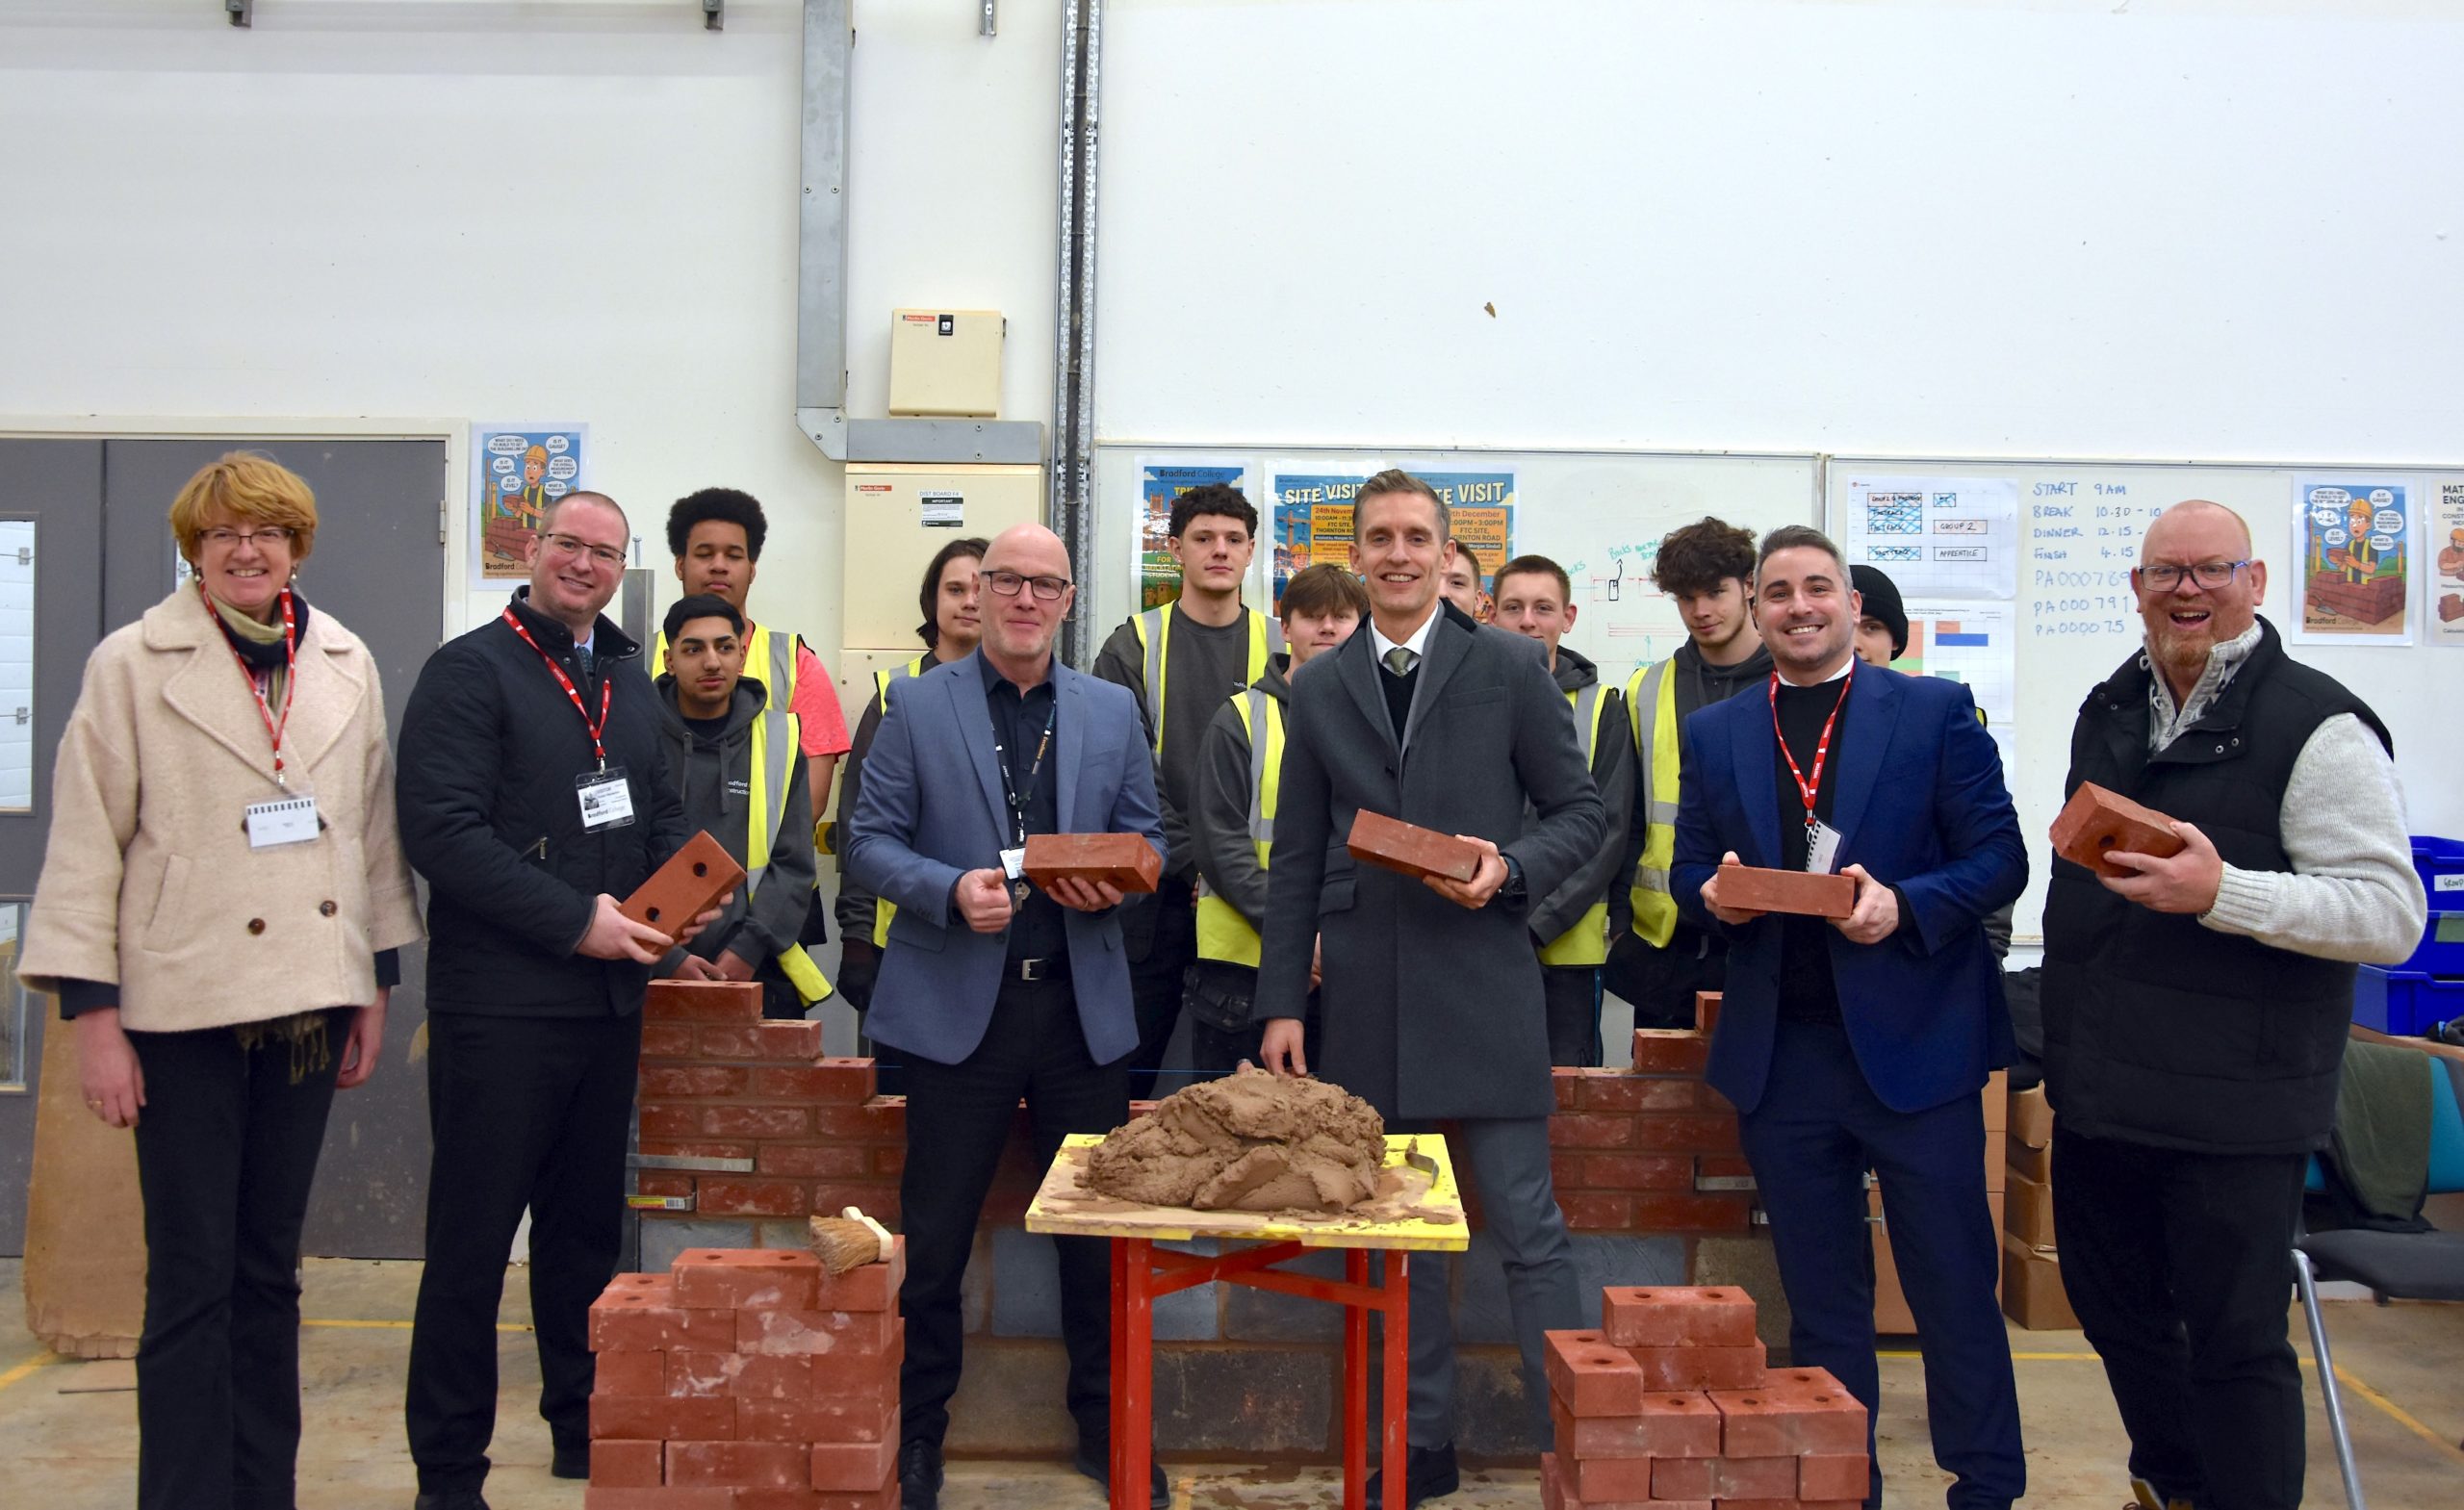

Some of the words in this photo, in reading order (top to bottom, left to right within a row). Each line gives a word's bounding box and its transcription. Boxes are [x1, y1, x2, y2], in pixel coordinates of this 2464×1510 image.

[1197, 470, 1225, 479] College
[1458, 482, 1505, 503] VISIT
[2033, 482, 2078, 496] START
[1285, 488, 1322, 504] SITE
[1434, 489, 1453, 505] TE
[2033, 505, 2073, 518] BREAK
[2096, 506, 2131, 517] 10.30
[1967, 522, 1977, 531] 2
[2033, 527, 2083, 538] DINNER
[1940, 549, 1978, 557] APPRENTICE
[2101, 546, 2133, 558] 4.15
